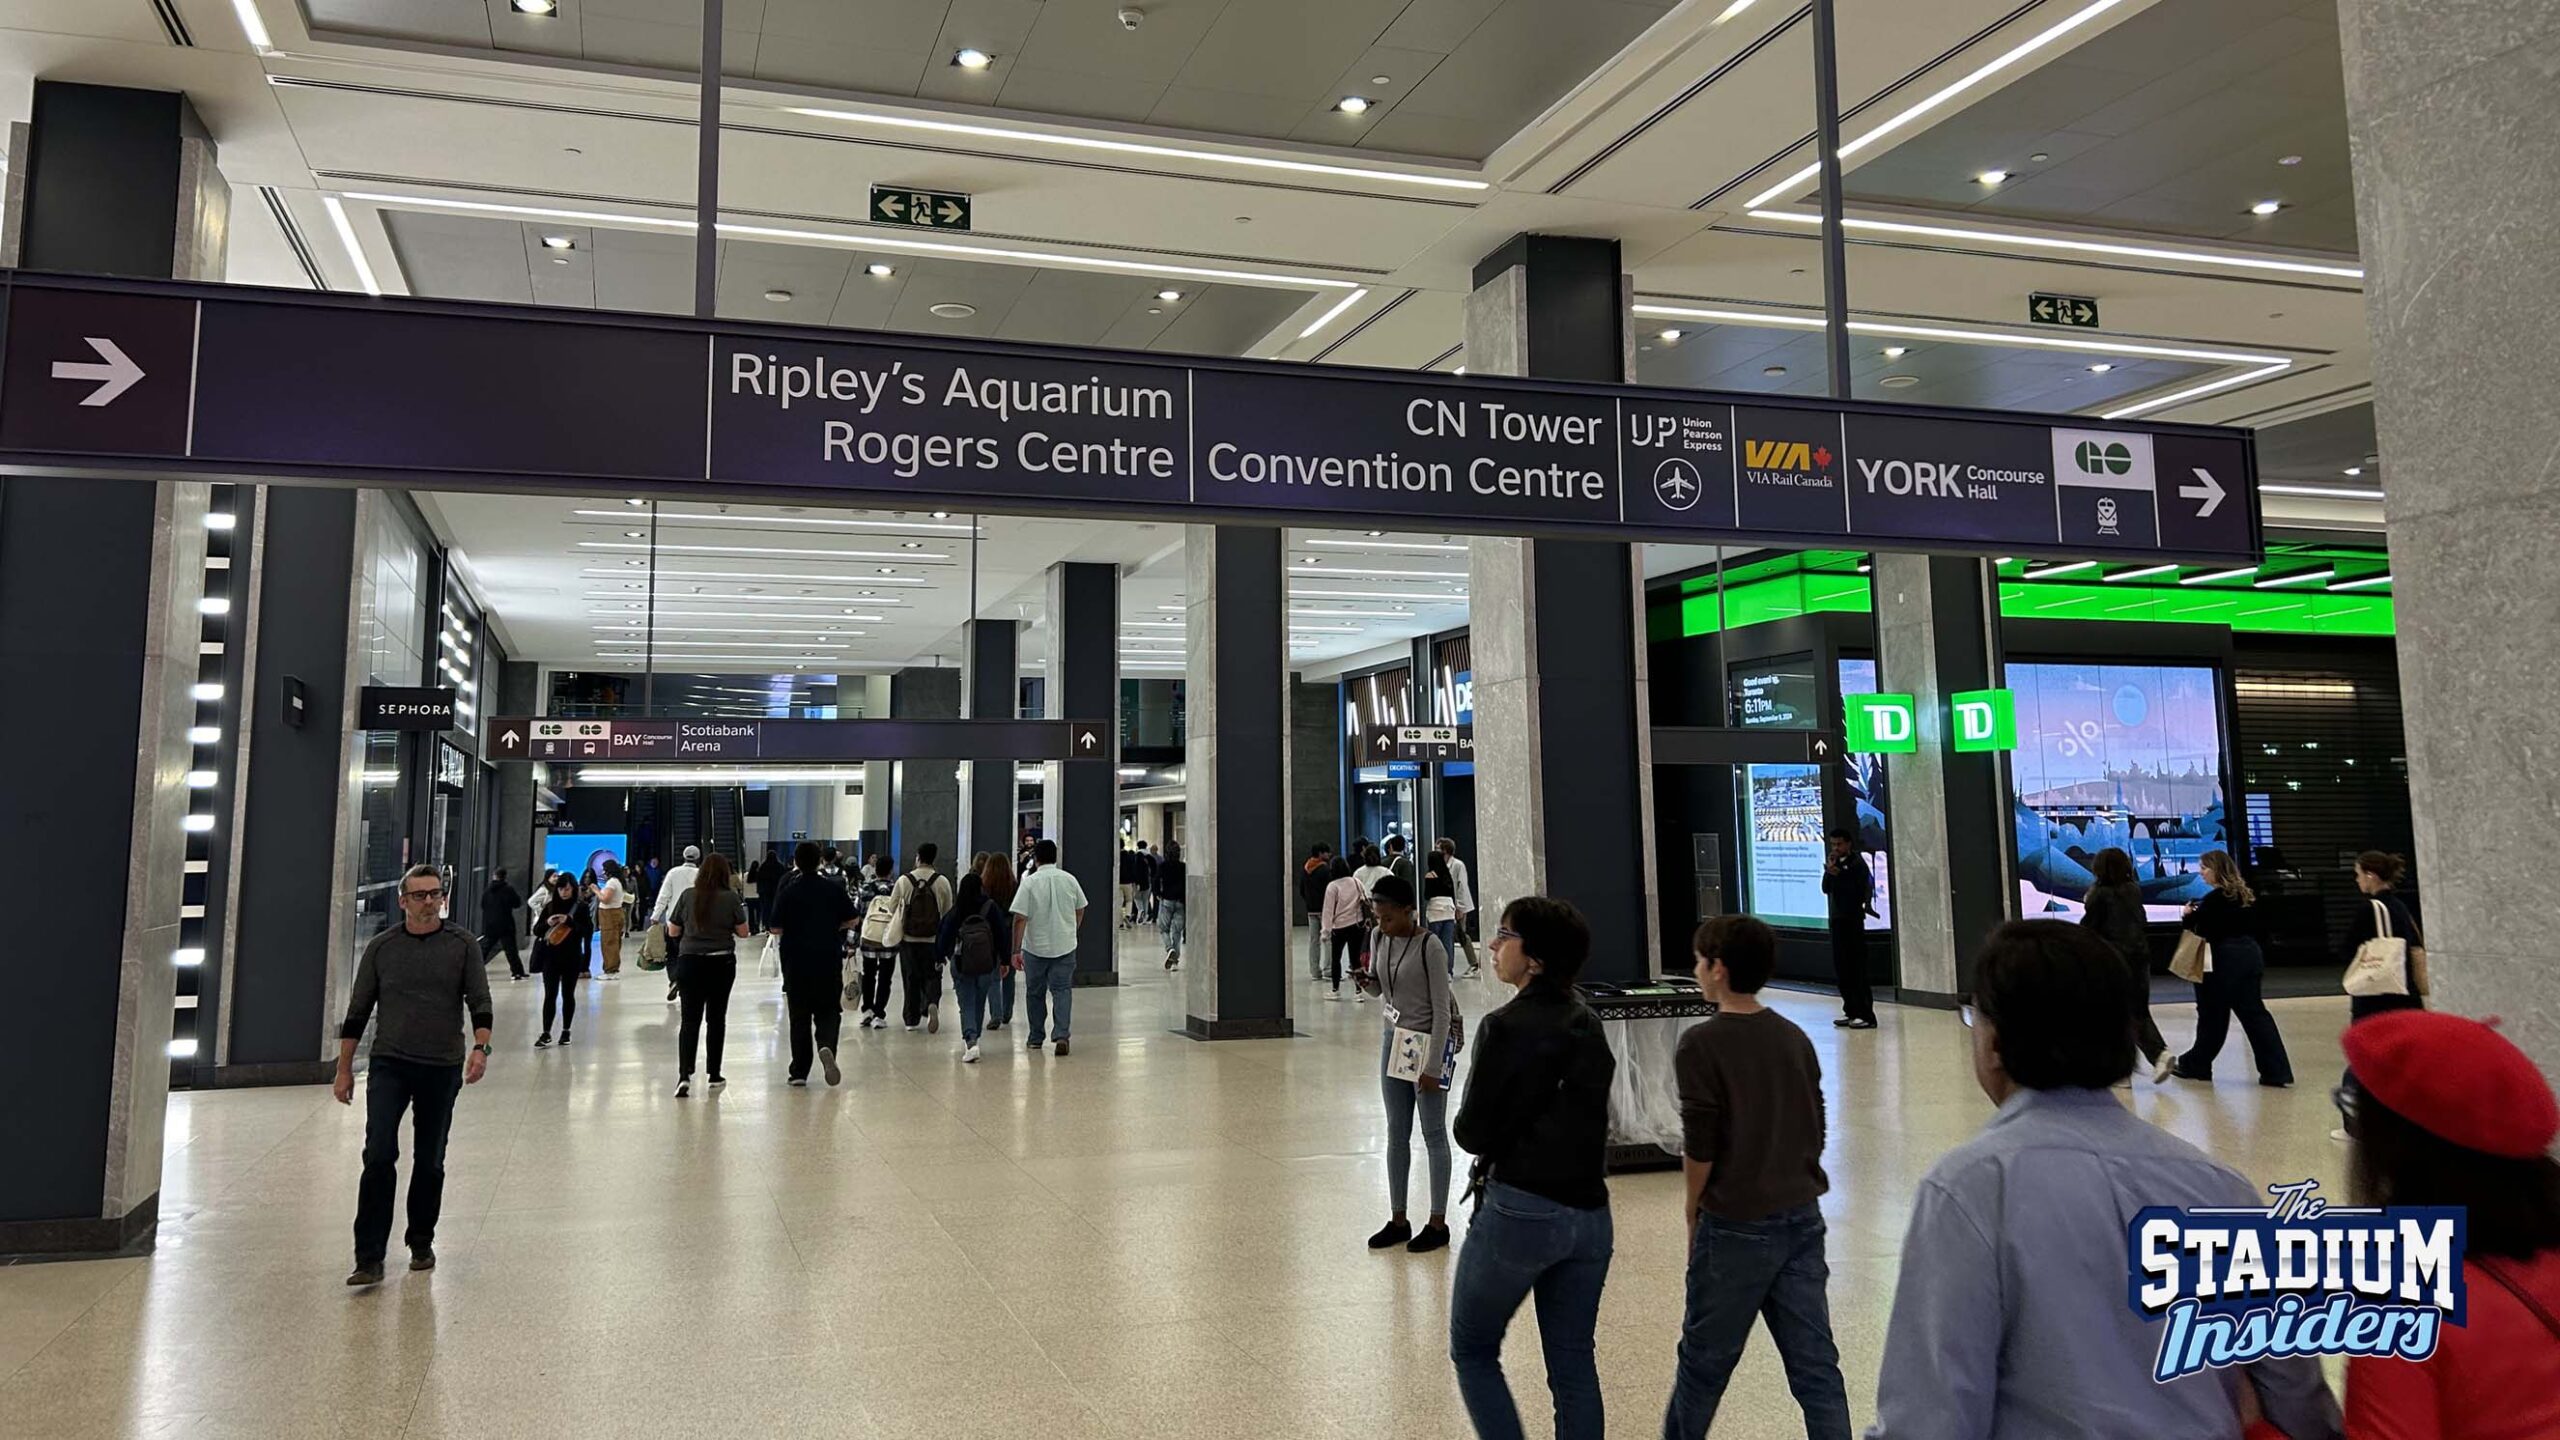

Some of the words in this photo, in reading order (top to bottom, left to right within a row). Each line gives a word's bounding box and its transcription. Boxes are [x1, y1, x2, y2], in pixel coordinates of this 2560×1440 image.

[731, 352, 926, 414] Ripley's
[943, 367, 1173, 423] Aquarium
[1406, 398, 1467, 438] CN
[1480, 402, 1604, 445] Tower
[1631, 413, 1677, 448] UP
[1682, 416, 1712, 429] Union
[1683, 428, 1723, 441] Pearson
[823, 420, 1000, 478] Rogers
[1017, 432, 1175, 478] Centre
[1683, 439, 1723, 452] Express
[1745, 439, 1811, 472] VIA
[2075, 440, 2132, 475] GO
[1207, 442, 1453, 493] Convention
[1469, 457, 1604, 499] Centre
[1747, 471, 1771, 485] VIA
[1772, 472, 1793, 486] Rail
[1794, 475, 1833, 488] Canada
[1856, 458, 1964, 498] YORK
[1966, 464, 2045, 484] Concourse
[1968, 483, 1998, 501] Hall
[379, 704, 451, 716] SEPHORA
[539, 724, 563, 736] GO
[579, 724, 603, 736] GO
[681, 723, 755, 737] Scotiabank
[1863, 704, 1911, 741] TD
[1955, 701, 1994, 740] TD
[613, 734, 642, 746] BAY
[680, 739, 721, 753] Arena
